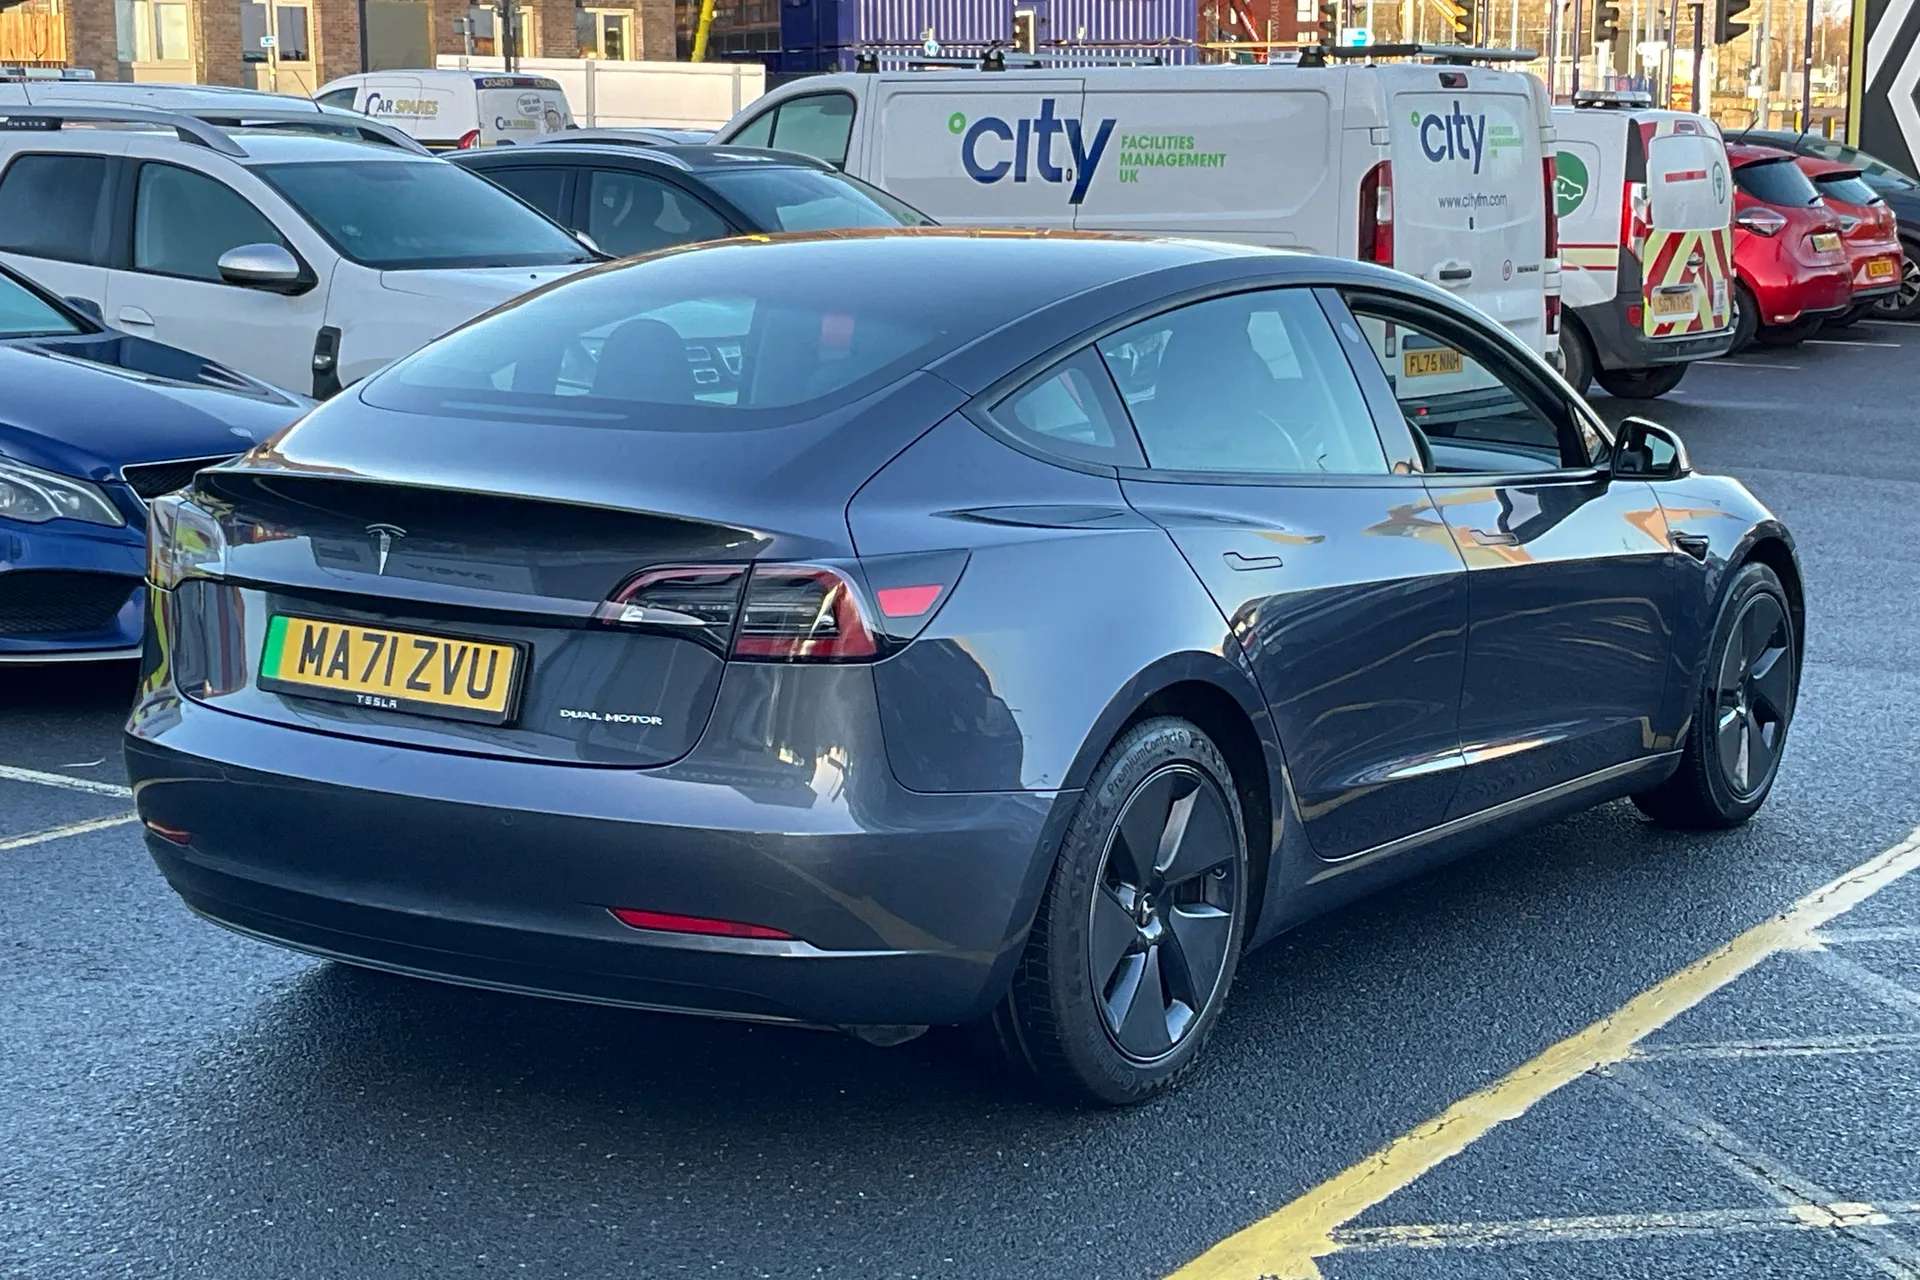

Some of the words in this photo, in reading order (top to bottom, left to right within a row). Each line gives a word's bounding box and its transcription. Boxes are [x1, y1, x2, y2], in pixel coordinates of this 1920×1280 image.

[1121, 135, 1195, 150] FACILITIES
[1119, 153, 1226, 168] MANAGEMENT
[1119, 169, 1139, 183] UK
[1438, 192, 1507, 209] www.cityfm.com
[356, 693, 397, 709] TESLA
[559, 709, 602, 721] DUAL
[604, 713, 663, 726] MOTOR
